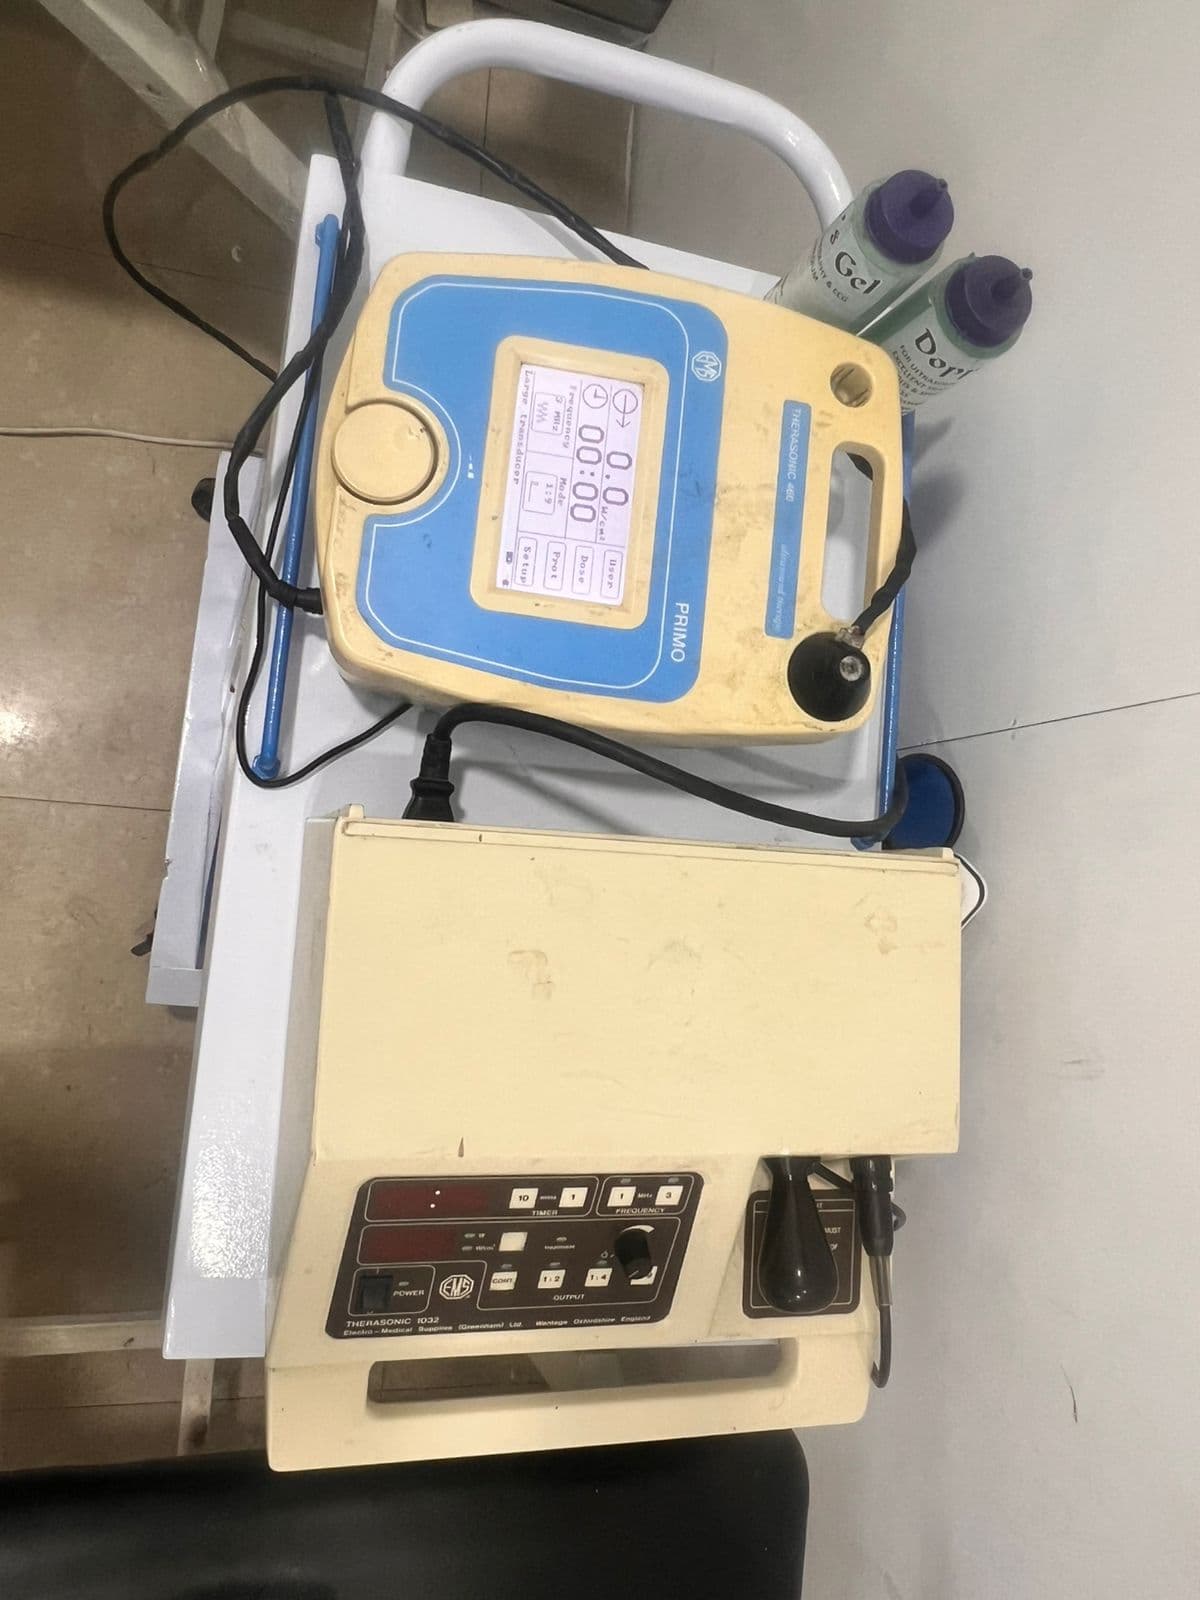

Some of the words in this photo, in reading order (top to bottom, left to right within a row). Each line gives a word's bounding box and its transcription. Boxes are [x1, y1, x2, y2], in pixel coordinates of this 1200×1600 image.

[834, 250, 882, 295] Gel
[520, 370, 533, 405] Large
[562, 385, 577, 449] Frequency
[513, 414, 528, 485] transducer
[787, 408, 802, 480] THERASONIC
[569, 424, 605, 523] 00:00
[602, 451, 633, 506] 0.0
[544, 483, 554, 504] 1:9
[558, 477, 568, 506] Mode
[519, 546, 532, 584] Setup
[550, 551, 561, 580] Prot
[578, 555, 589, 584] Dose
[606, 559, 617, 589] User
[670, 602, 690, 662] PRIMO
[517, 1193, 530, 1203] 10
[665, 1191, 673, 1200] 3
[532, 1209, 559, 1217] TIMER
[615, 1207, 666, 1215] FREQUENCY
[393, 1289, 425, 1297] POWER
[441, 1276, 472, 1298] EMS
[346, 1317, 412, 1328] THERASONIC
[417, 1316, 440, 1324] 1032
